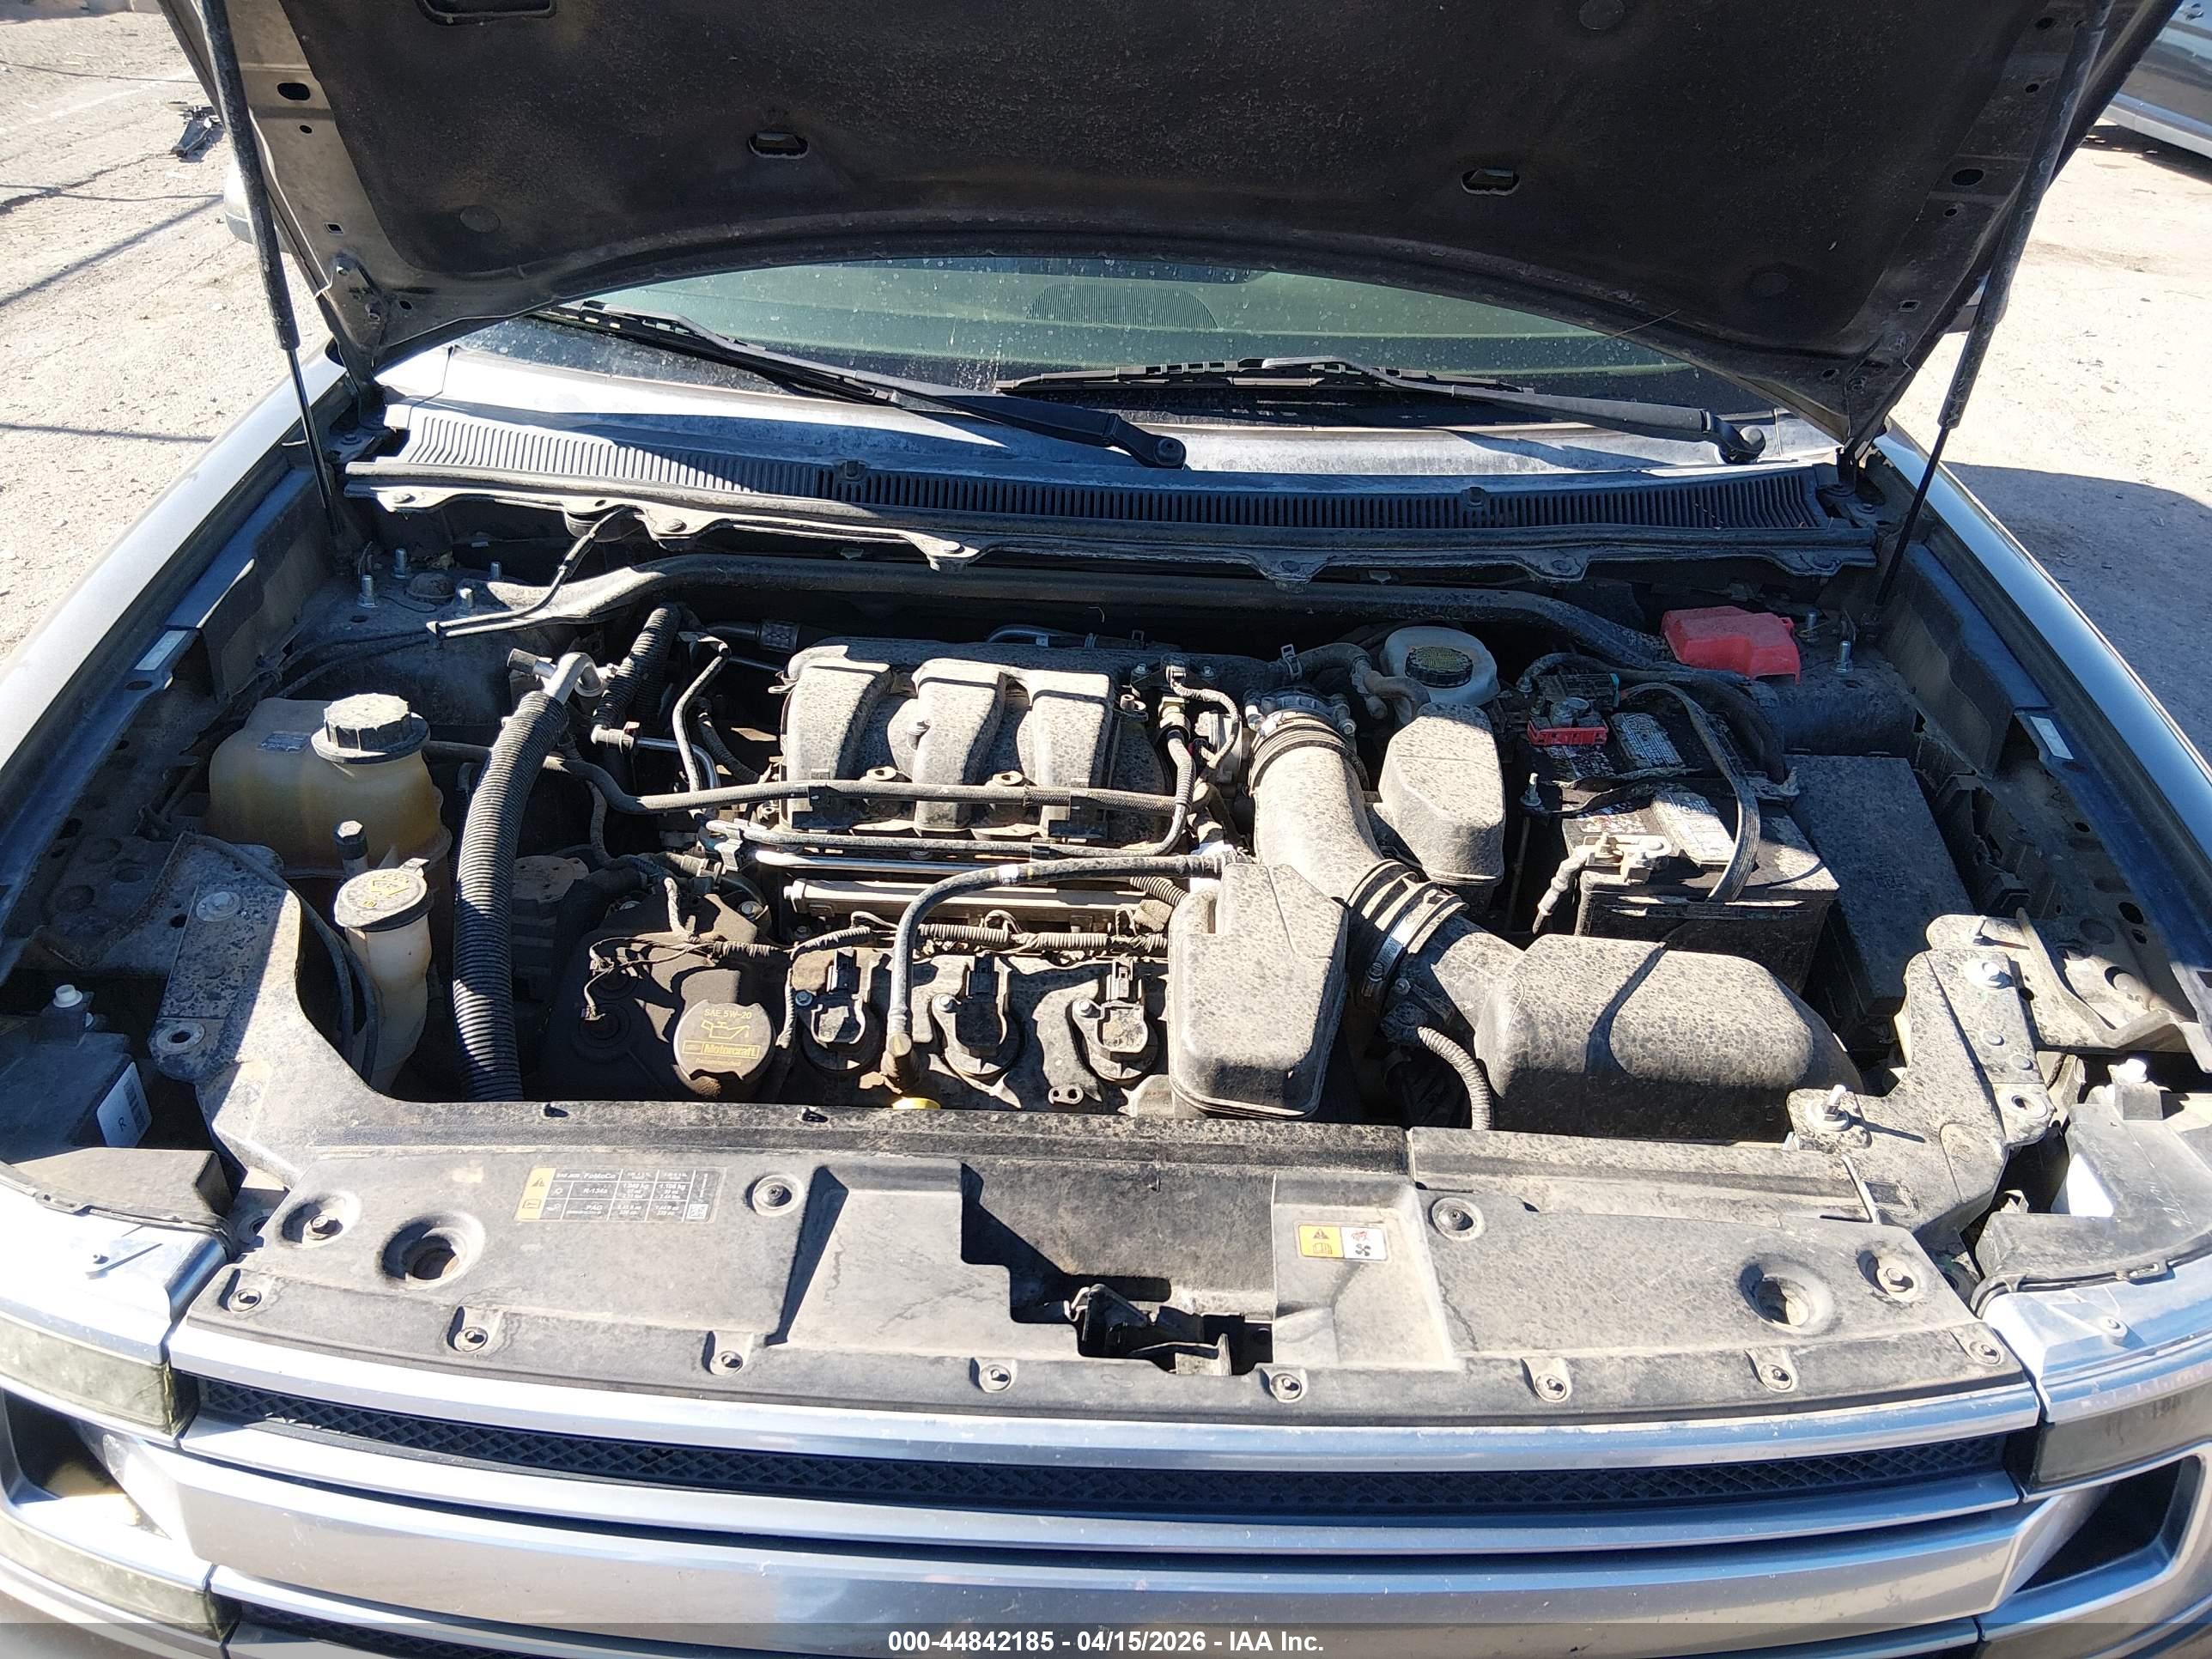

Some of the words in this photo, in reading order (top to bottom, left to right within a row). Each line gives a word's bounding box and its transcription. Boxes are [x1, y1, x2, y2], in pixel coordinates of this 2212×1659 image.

[703, 1008, 721, 1017] SAE
[723, 1009, 752, 1019] 5W-20
[703, 1043, 757, 1057] Motorcraft
